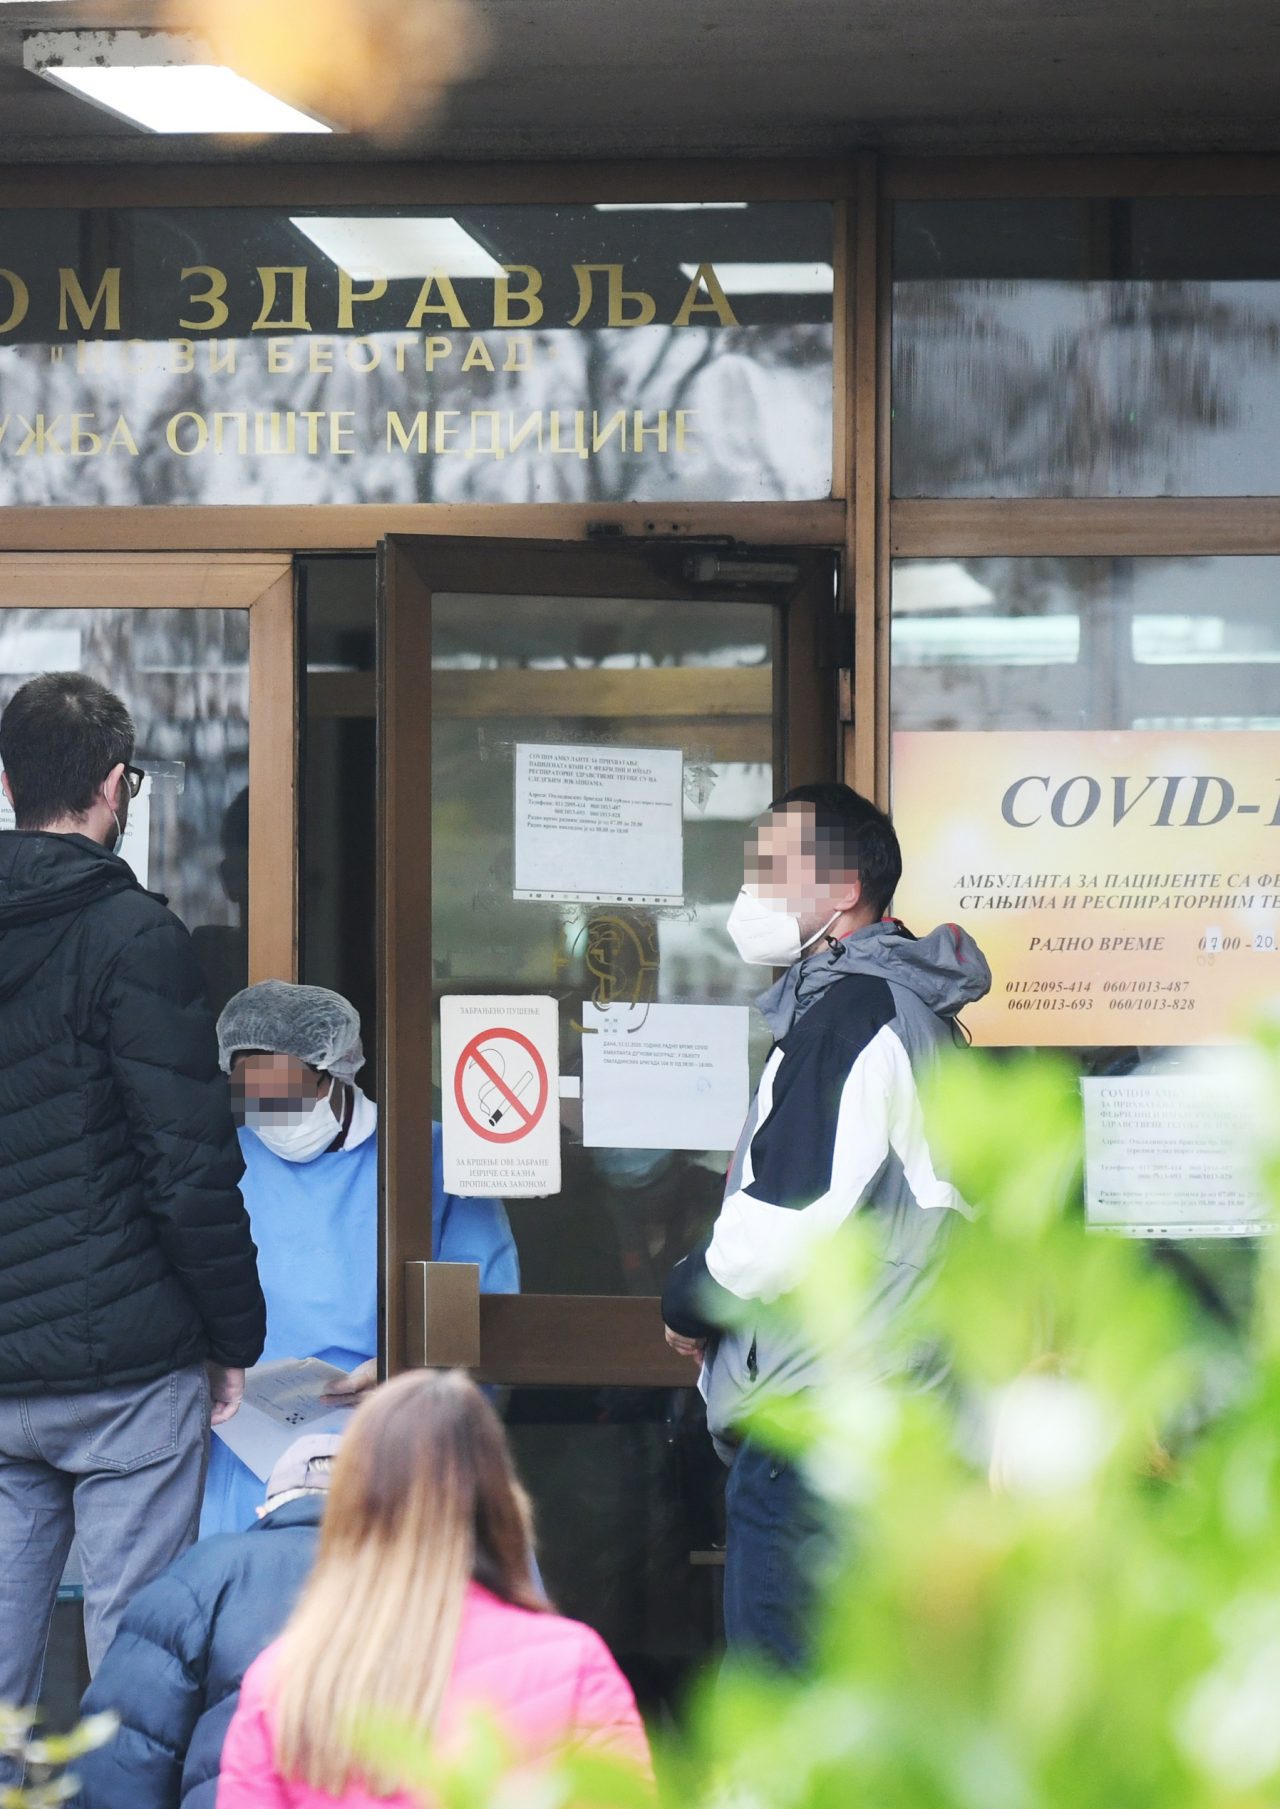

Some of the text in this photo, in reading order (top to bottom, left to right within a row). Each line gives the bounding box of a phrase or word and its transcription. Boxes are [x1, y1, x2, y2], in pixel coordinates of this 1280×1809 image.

[179, 263, 740, 331] ЗДРАВЉА
[166, 411, 356, 456] ОПШТЕ
[387, 409, 700, 459] МЕДИЦИНЕ
[954, 874, 1071, 888] АМБУЛАНТА
[1078, 874, 1098, 888] ЗА
[1104, 873, 1222, 889] ПАЦИЈЕНТЕ
[1227, 873, 1250, 888] СА
[960, 895, 1056, 909] СТАЊИМА
[1062, 895, 1078, 909] И
[1081, 894, 1255, 909] РЕСПИРАТОРНИМ
[1029, 936, 1095, 953] РАДНО
[1099, 936, 1166, 951] ВРЕМЕ
[1005, 980, 1190, 993] 011/2095-414 060/1013-487
[459, 1006, 541, 1016] ЗАБРАЊЕНО ПУШЕЊЕ
[1008, 998, 1196, 1011] 060/1013-693 060/1013-828
[456, 1158, 550, 1168] ЗА КРШЕЊЕ ОВЕ ЗАБРАНЕ
[469, 1169, 536, 1178] ИЗРИЧЕ СЕ КАЗНА
[459, 1179, 547, 1189] ПРОПИСАНА ЗАКОНОМ
